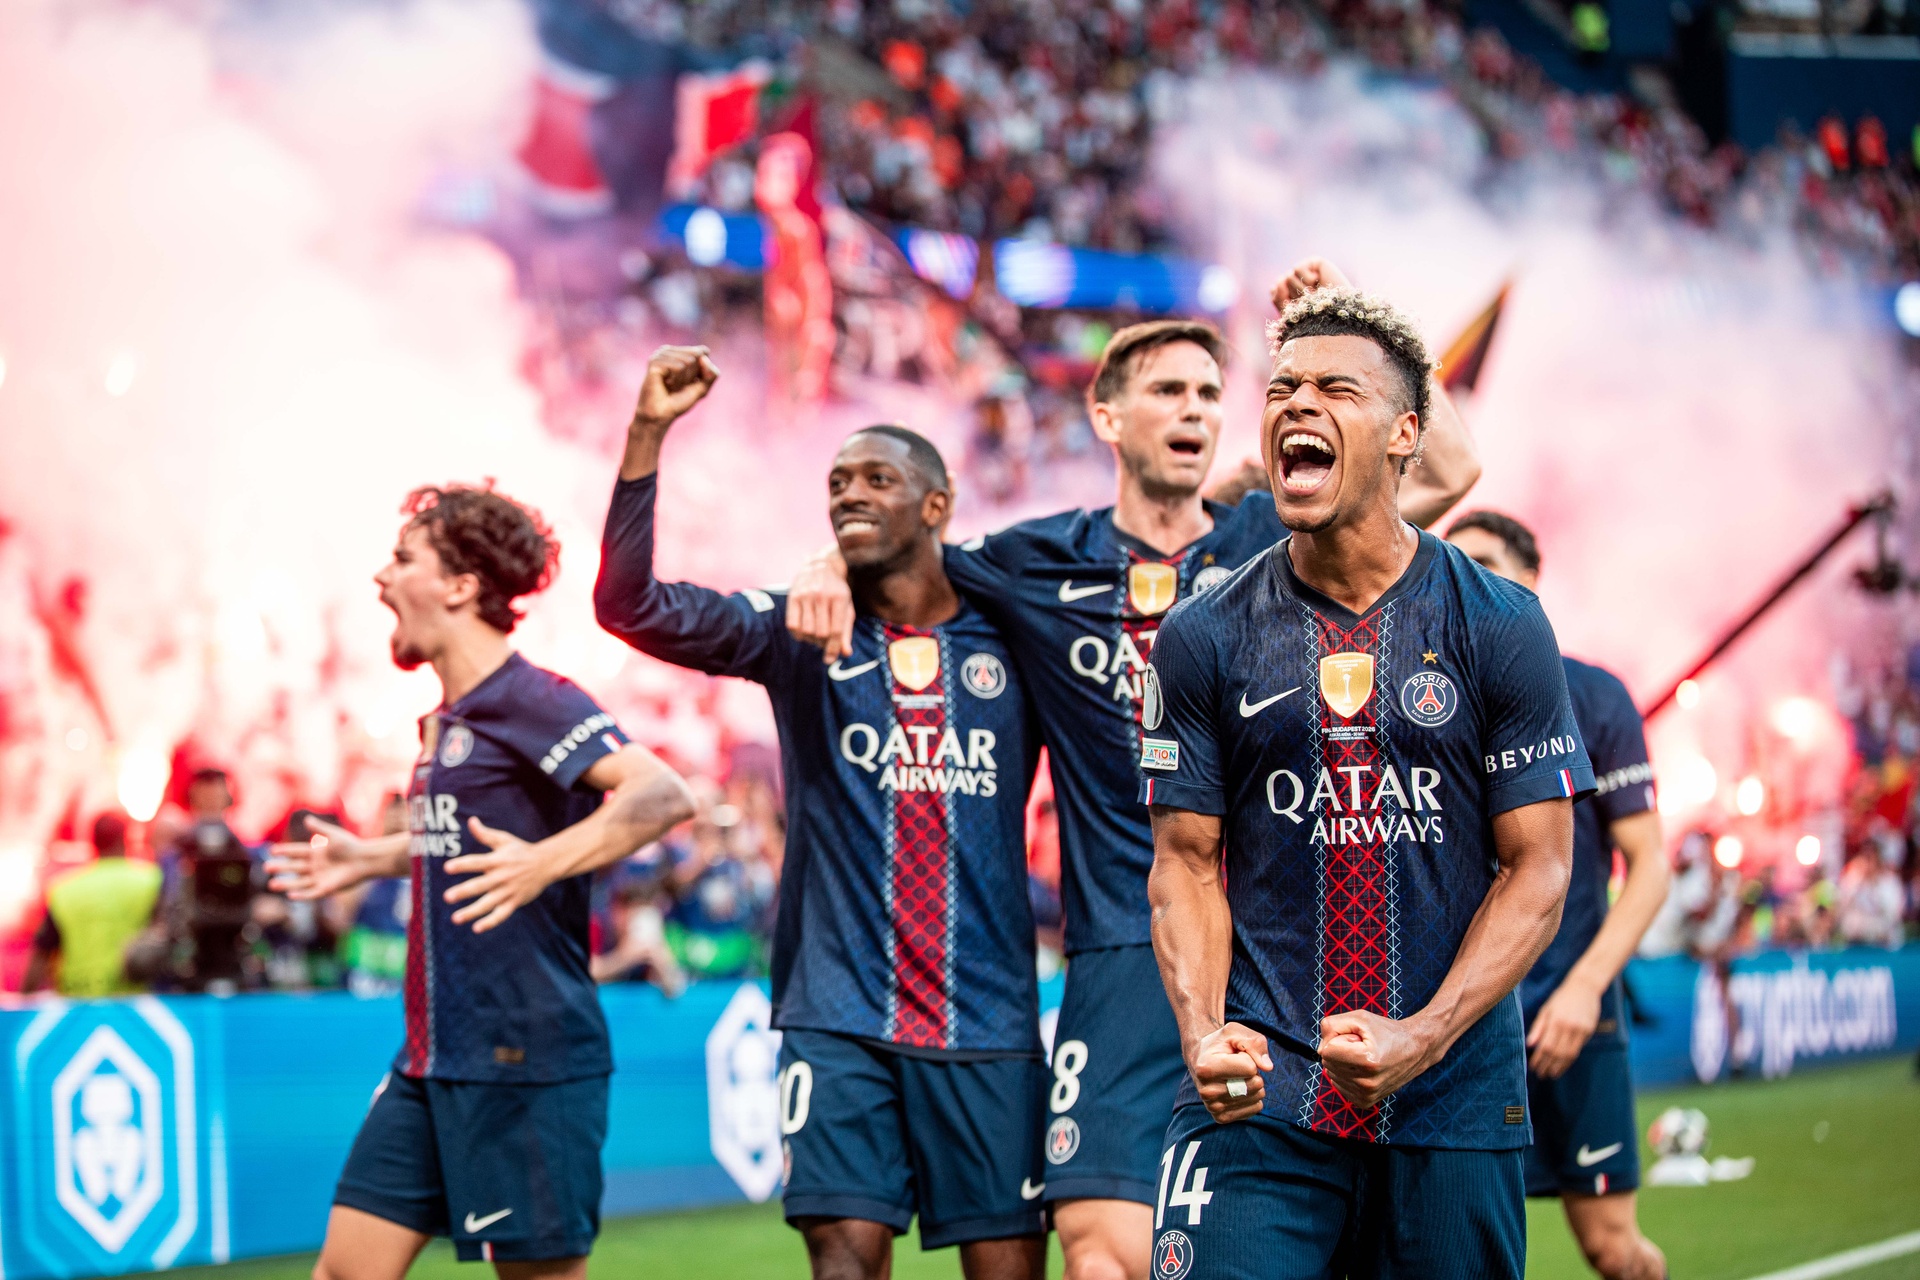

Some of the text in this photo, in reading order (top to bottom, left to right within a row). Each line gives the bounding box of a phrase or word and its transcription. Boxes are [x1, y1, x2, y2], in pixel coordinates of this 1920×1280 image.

[1411, 674, 1448, 689] PARIS
[839, 722, 998, 773] QATAR
[1485, 734, 1576, 774] BEYOND
[877, 765, 998, 798] AIRWAYS
[1266, 764, 1443, 825] QATAR
[1593, 762, 1653, 797] BEYON
[1308, 814, 1444, 845] AIRWAYS
[1050, 1040, 1089, 1114] 8
[777, 1060, 814, 1136] 0
[1155, 1140, 1214, 1230] 14
[1159, 1233, 1186, 1248] PARIS
